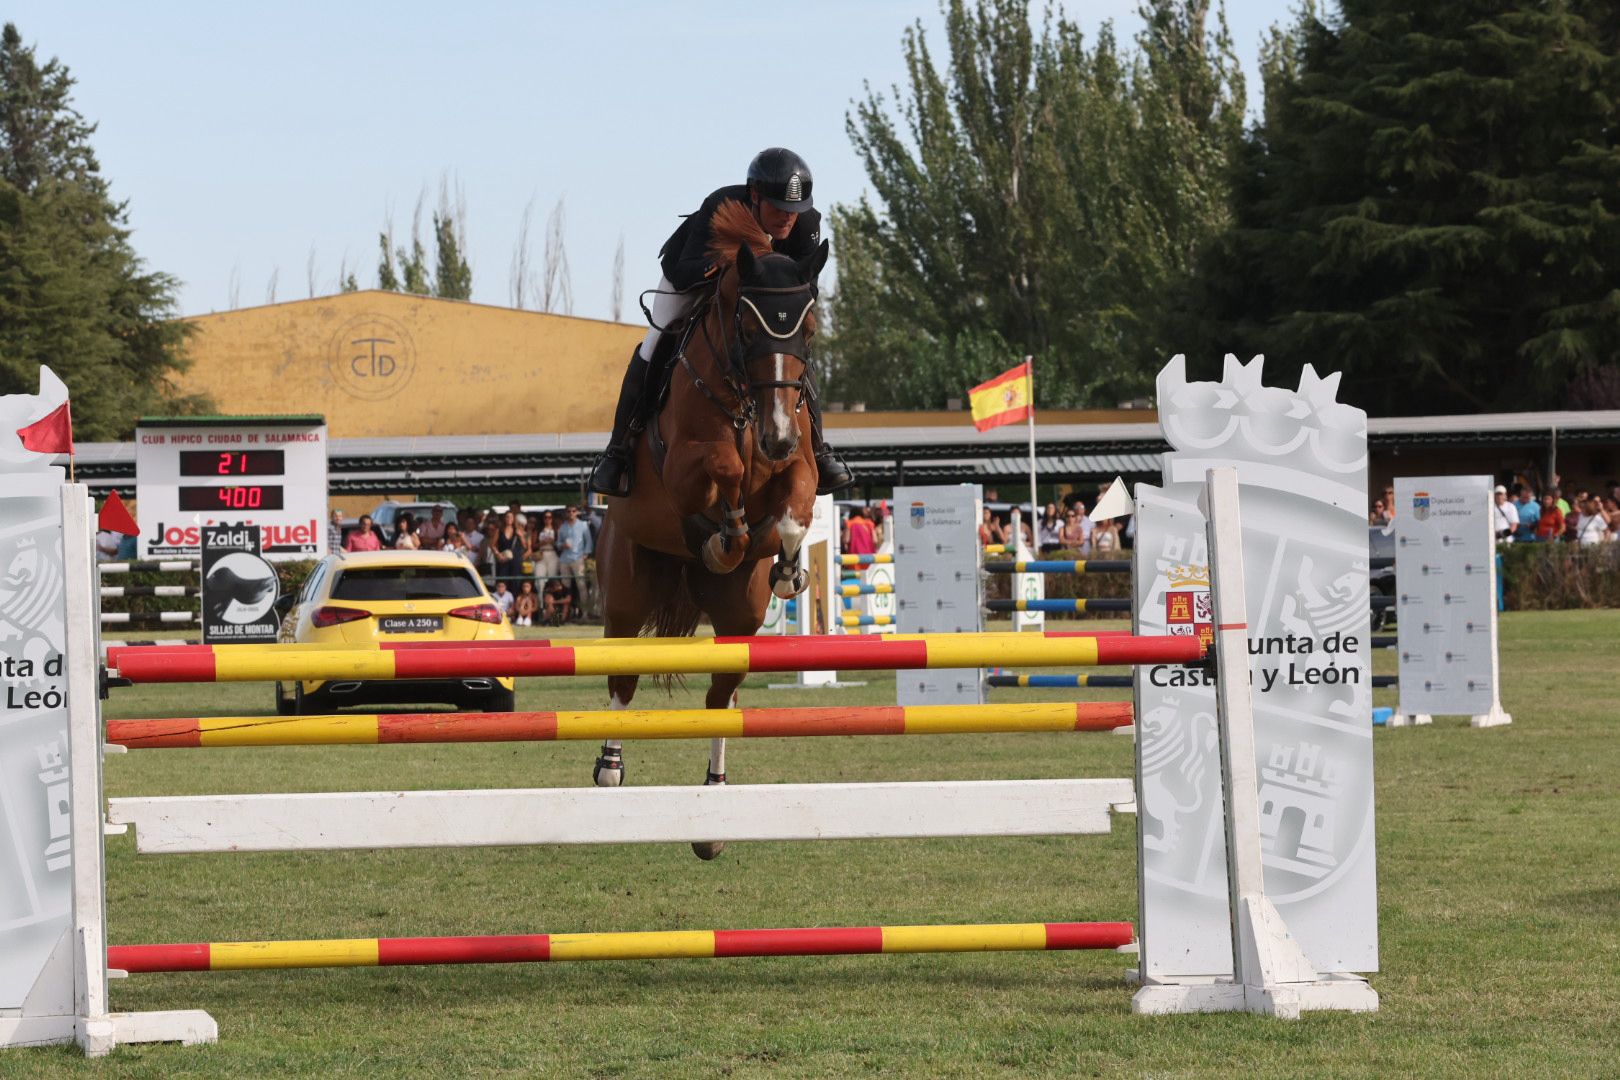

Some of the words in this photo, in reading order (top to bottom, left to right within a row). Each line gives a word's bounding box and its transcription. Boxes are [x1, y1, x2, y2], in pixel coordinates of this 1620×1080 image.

[142, 435, 165, 444] CLUB
[208, 434, 242, 443] CIUDAD
[247, 434, 259, 443] DE
[265, 433, 320, 443] SALAMANCA
[218, 453, 247, 474] 21
[219, 487, 262, 508] 400
[206, 530, 249, 547] Zaldi
[209, 625, 234, 635] SILLAS
[234, 625, 244, 634] DE
[244, 624, 274, 634] MONTAR
[384, 619, 406, 628] Clase
[407, 619, 415, 627] A
[416, 618, 431, 627] 250
[1247, 634, 1313, 654] unta
[1323, 632, 1359, 653] de
[44, 654, 67, 677] d
[1261, 668, 1279, 693] y
[1288, 662, 1360, 685] León
